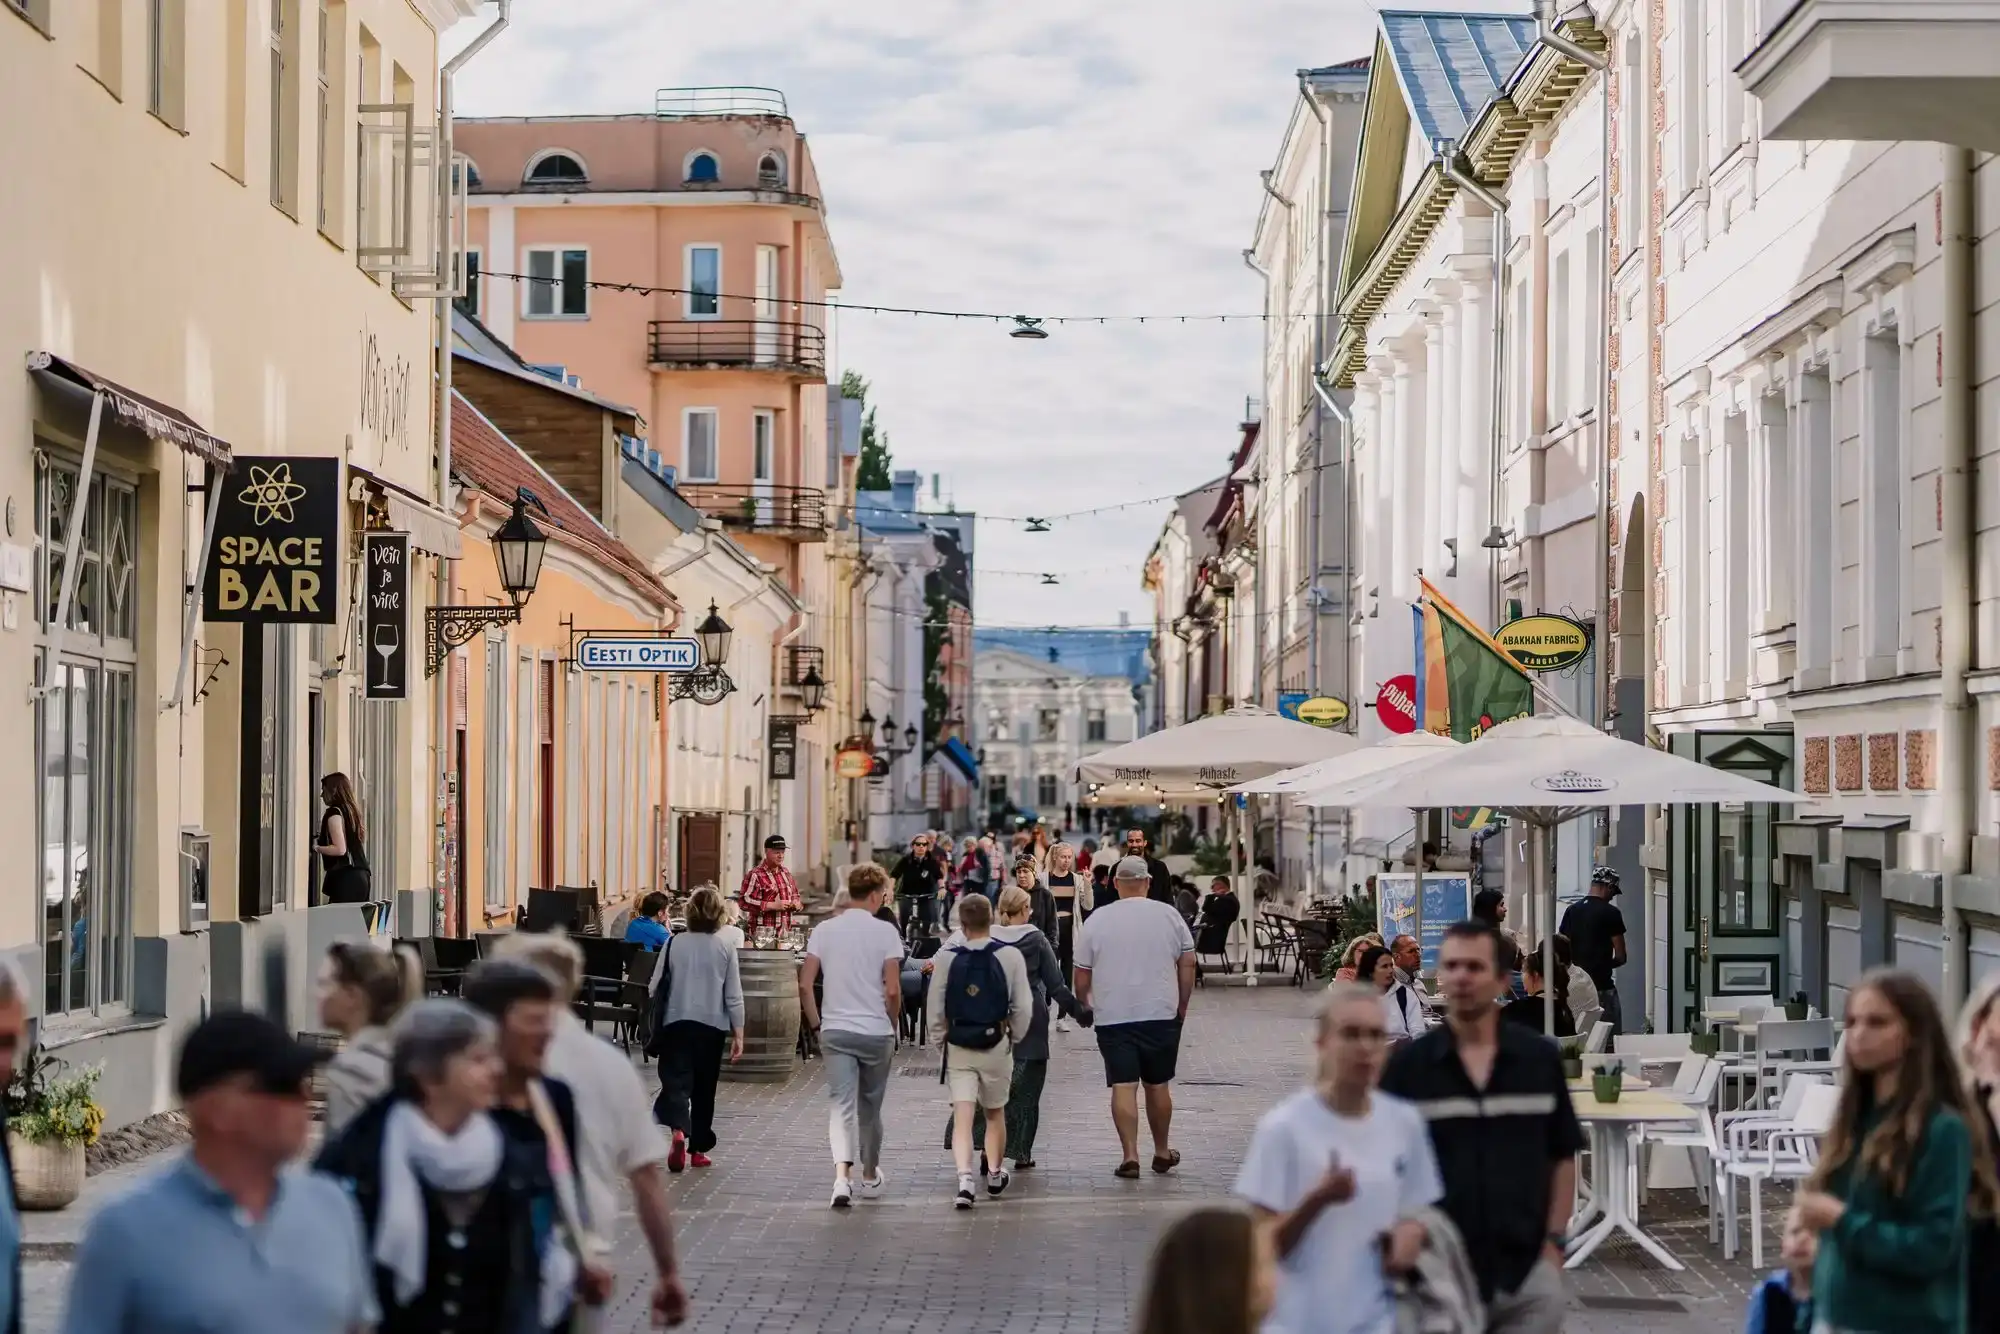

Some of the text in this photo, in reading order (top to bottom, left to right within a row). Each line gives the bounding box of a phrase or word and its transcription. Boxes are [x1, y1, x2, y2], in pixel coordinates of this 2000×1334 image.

[220, 536, 322, 566] SPACE
[371, 544, 400, 565] Vein
[379, 568, 392, 588] ja
[218, 568, 320, 612] BAR
[371, 591, 400, 610] vine
[1502, 635, 1580, 646] ABAKHAN FABRICS
[588, 647, 688, 662] EESTI OPTIK
